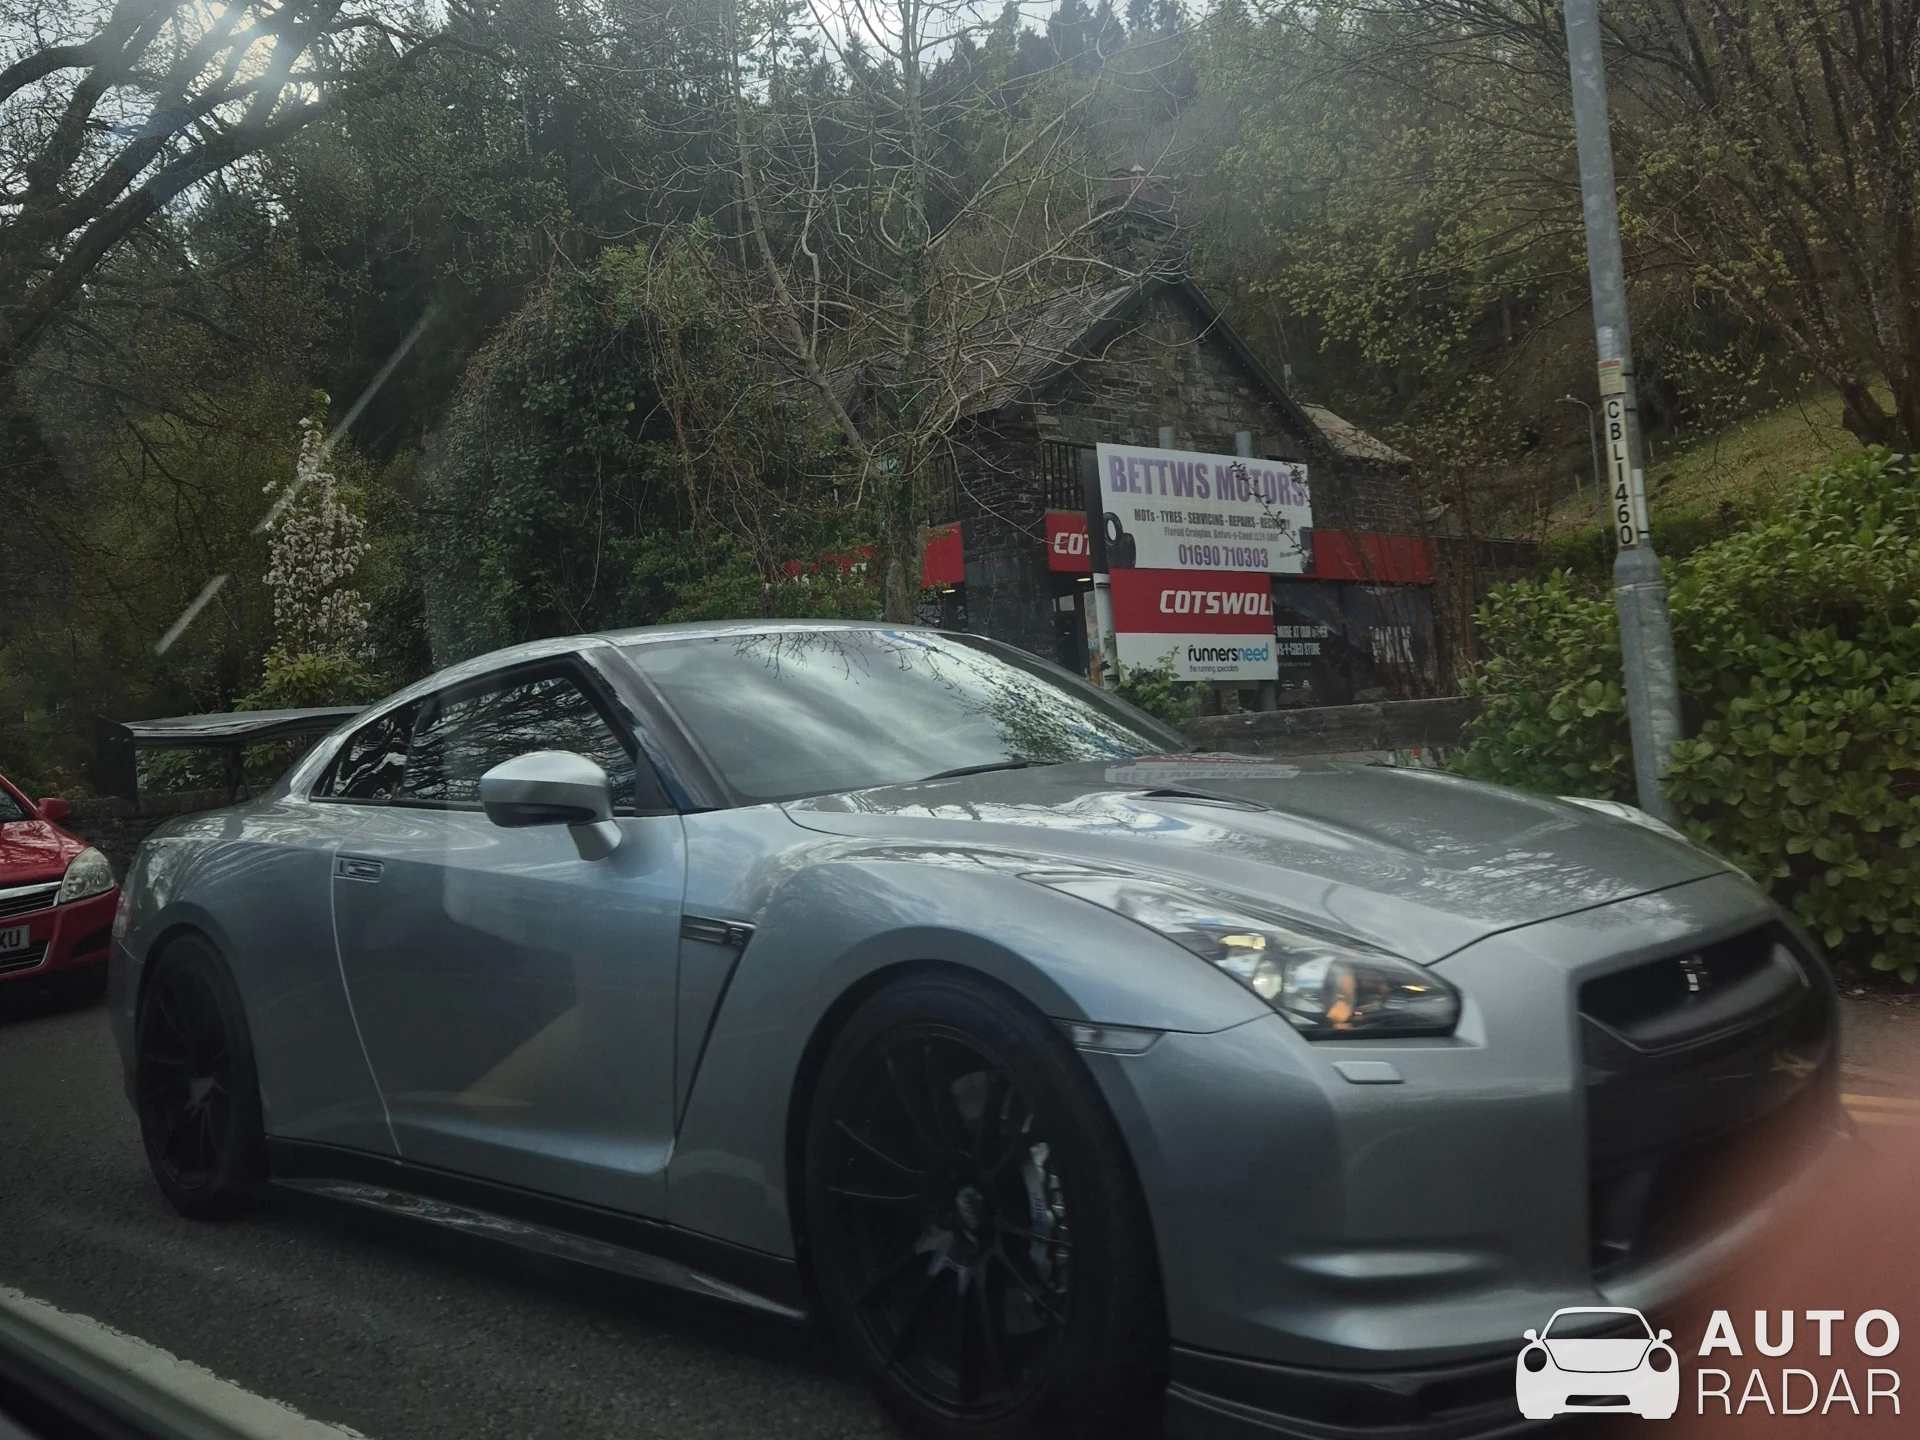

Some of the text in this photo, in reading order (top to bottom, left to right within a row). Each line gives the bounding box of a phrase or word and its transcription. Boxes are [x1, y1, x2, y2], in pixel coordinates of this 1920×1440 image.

[1108, 454, 1305, 507] BETTWS MOTORS
[1607, 400, 1633, 545] CBL1460
[1134, 508, 1155, 522] MOTs
[1160, 510, 1182, 523] TYRES
[1187, 512, 1224, 526] SERVICING
[1229, 515, 1255, 528] REPAIRS
[1260, 517, 1290, 530] RECOY
[1178, 543, 1269, 568] 01690 710303
[1159, 589, 1274, 616] COTSWOL
[1277, 625, 1293, 638] MORE
[1293, 625, 1300, 638] AT
[1300, 625, 1312, 638] OUR
[1188, 642, 1269, 662] runnersneed
[1304, 642, 1321, 656] STORE
